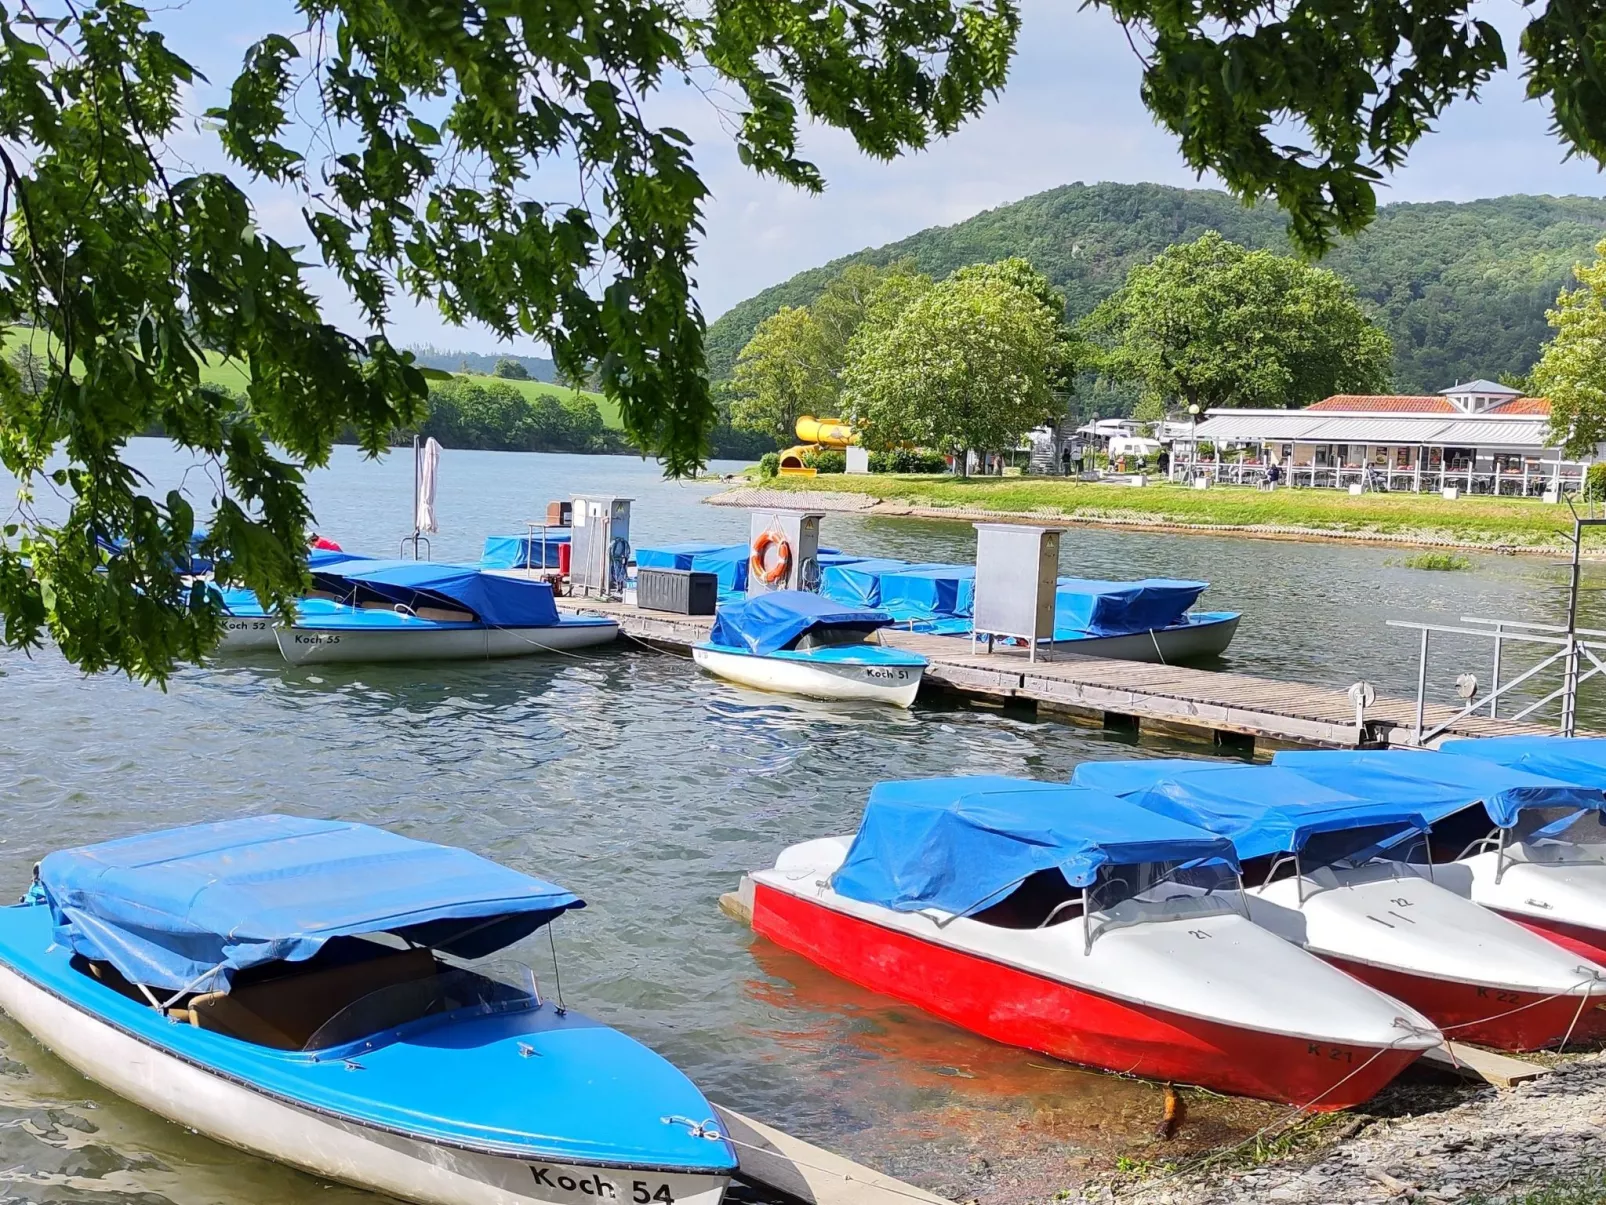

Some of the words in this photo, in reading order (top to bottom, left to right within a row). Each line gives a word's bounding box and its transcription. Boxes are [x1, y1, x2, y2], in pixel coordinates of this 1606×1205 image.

[221, 620, 248, 630] Koch
[252, 622, 266, 630] 52
[295, 635, 322, 644] Koch
[326, 635, 340, 644] 55
[866, 669, 894, 679] Koch
[898, 670, 909, 680] 51
[1390, 897, 1414, 907] 22
[1188, 929, 1212, 940] 21
[1476, 987, 1488, 999] K
[1496, 992, 1520, 1004] 22
[1307, 1043, 1320, 1056] K
[1329, 1047, 1353, 1063] 21
[529, 1165, 615, 1198] Koch
[632, 1180, 675, 1205] 54
